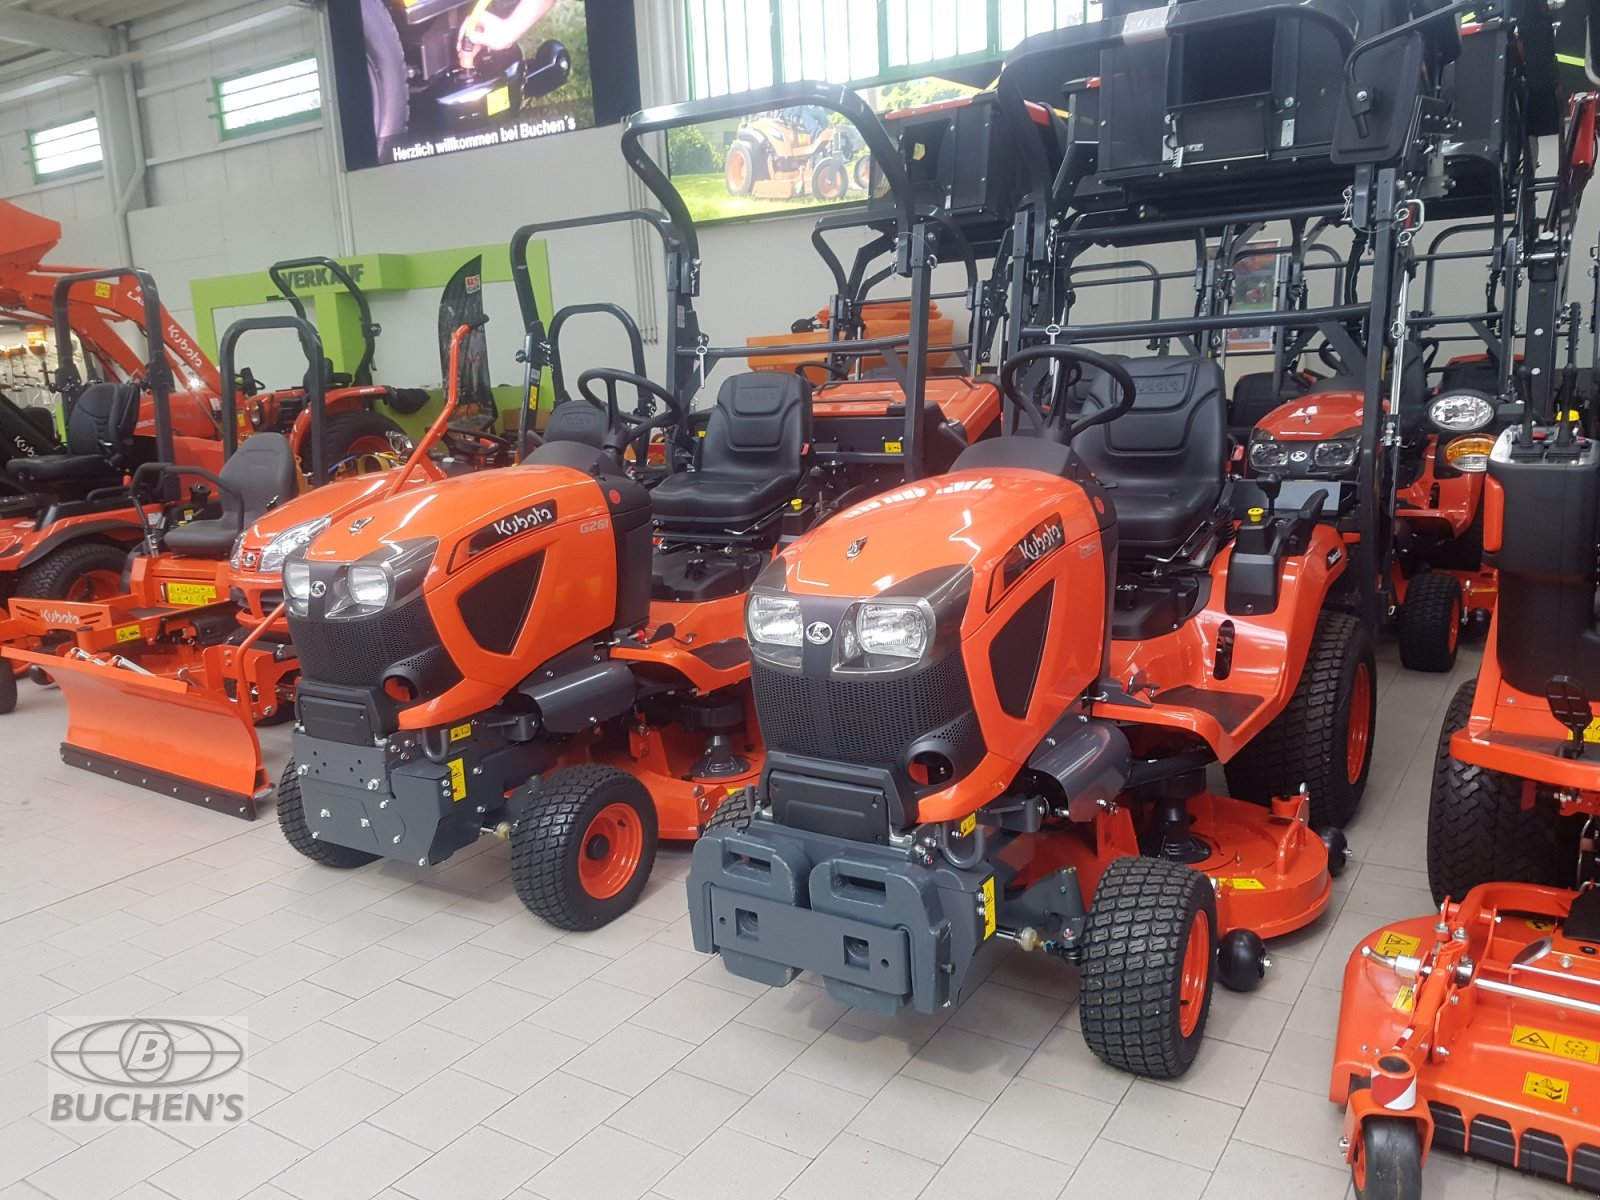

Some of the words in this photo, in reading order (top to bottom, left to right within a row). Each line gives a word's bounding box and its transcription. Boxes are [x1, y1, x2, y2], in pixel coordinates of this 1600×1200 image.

[393, 142, 435, 161] Herzlich
[436, 132, 499, 154] willkommen
[500, 127, 519, 142] bei
[168, 324, 203, 368] Kubota
[493, 507, 552, 535] Kubota
[580, 518, 609, 534] G261
[1018, 523, 1062, 560] Kubota
[40, 608, 80, 625] Kubota
